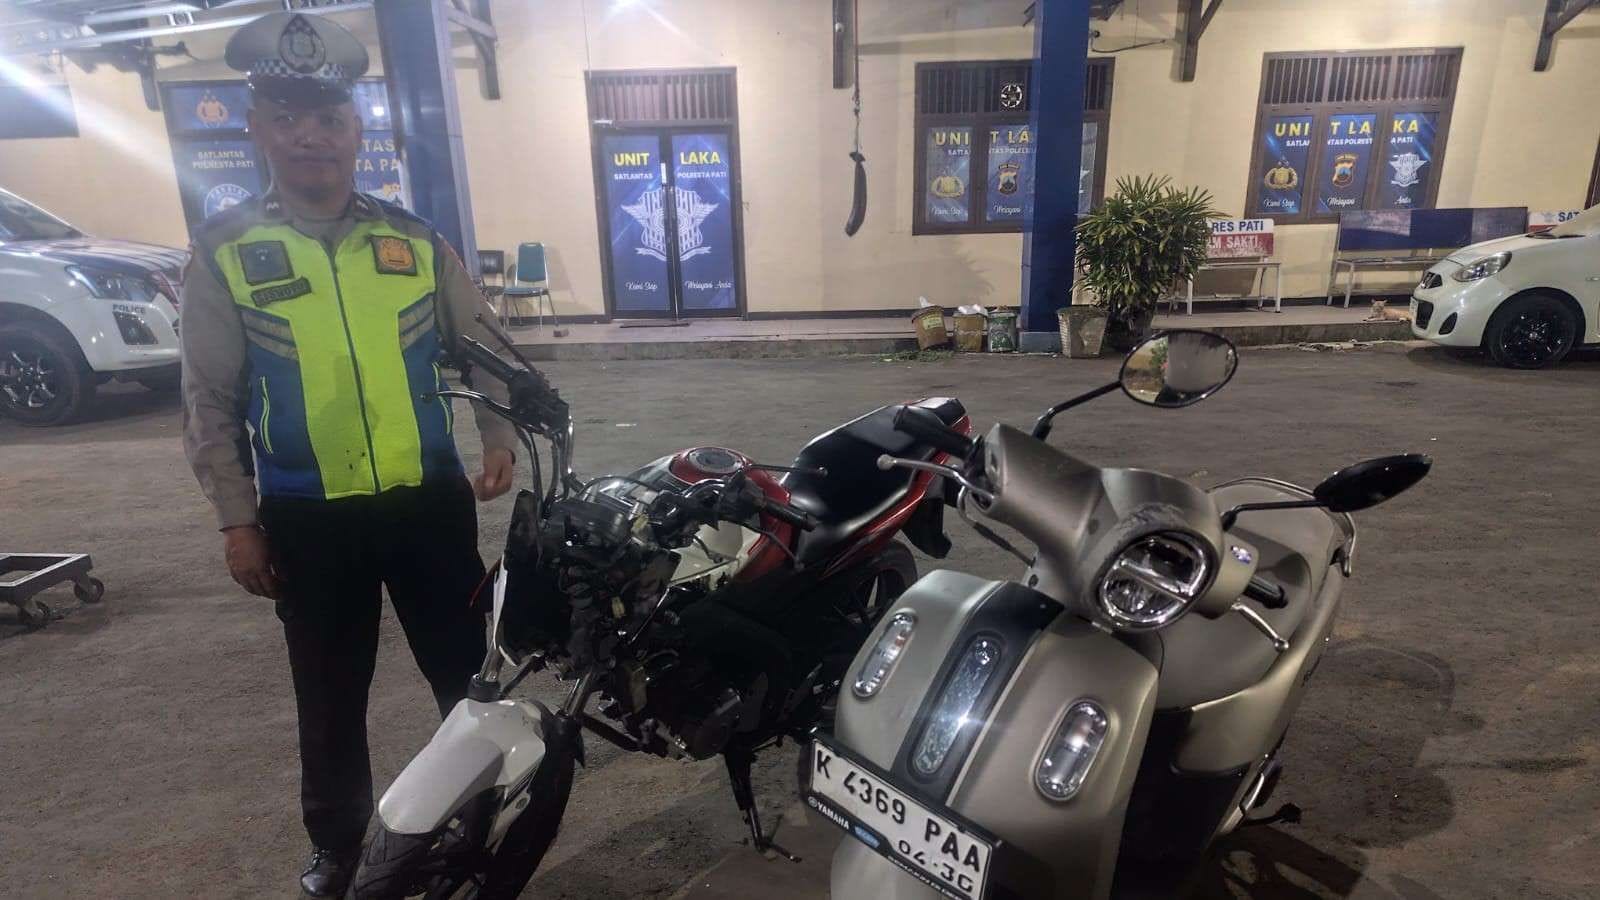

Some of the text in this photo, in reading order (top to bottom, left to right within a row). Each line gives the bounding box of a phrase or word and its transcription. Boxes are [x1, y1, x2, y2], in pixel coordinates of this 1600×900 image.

[356, 158, 401, 171] TA PA
[614, 151, 721, 166] UNIT LAKA
[614, 173, 654, 181] SATLANTAS
[1558, 211, 1580, 223] SAT
[1211, 220, 1264, 233] RES PATI
[1226, 234, 1258, 249] SAKTI
[112, 303, 146, 315] POLICE
[816, 750, 832, 779] K
[843, 771, 906, 825] 4369
[924, 818, 981, 873] PAA
[816, 801, 850, 830] YAMAHA
